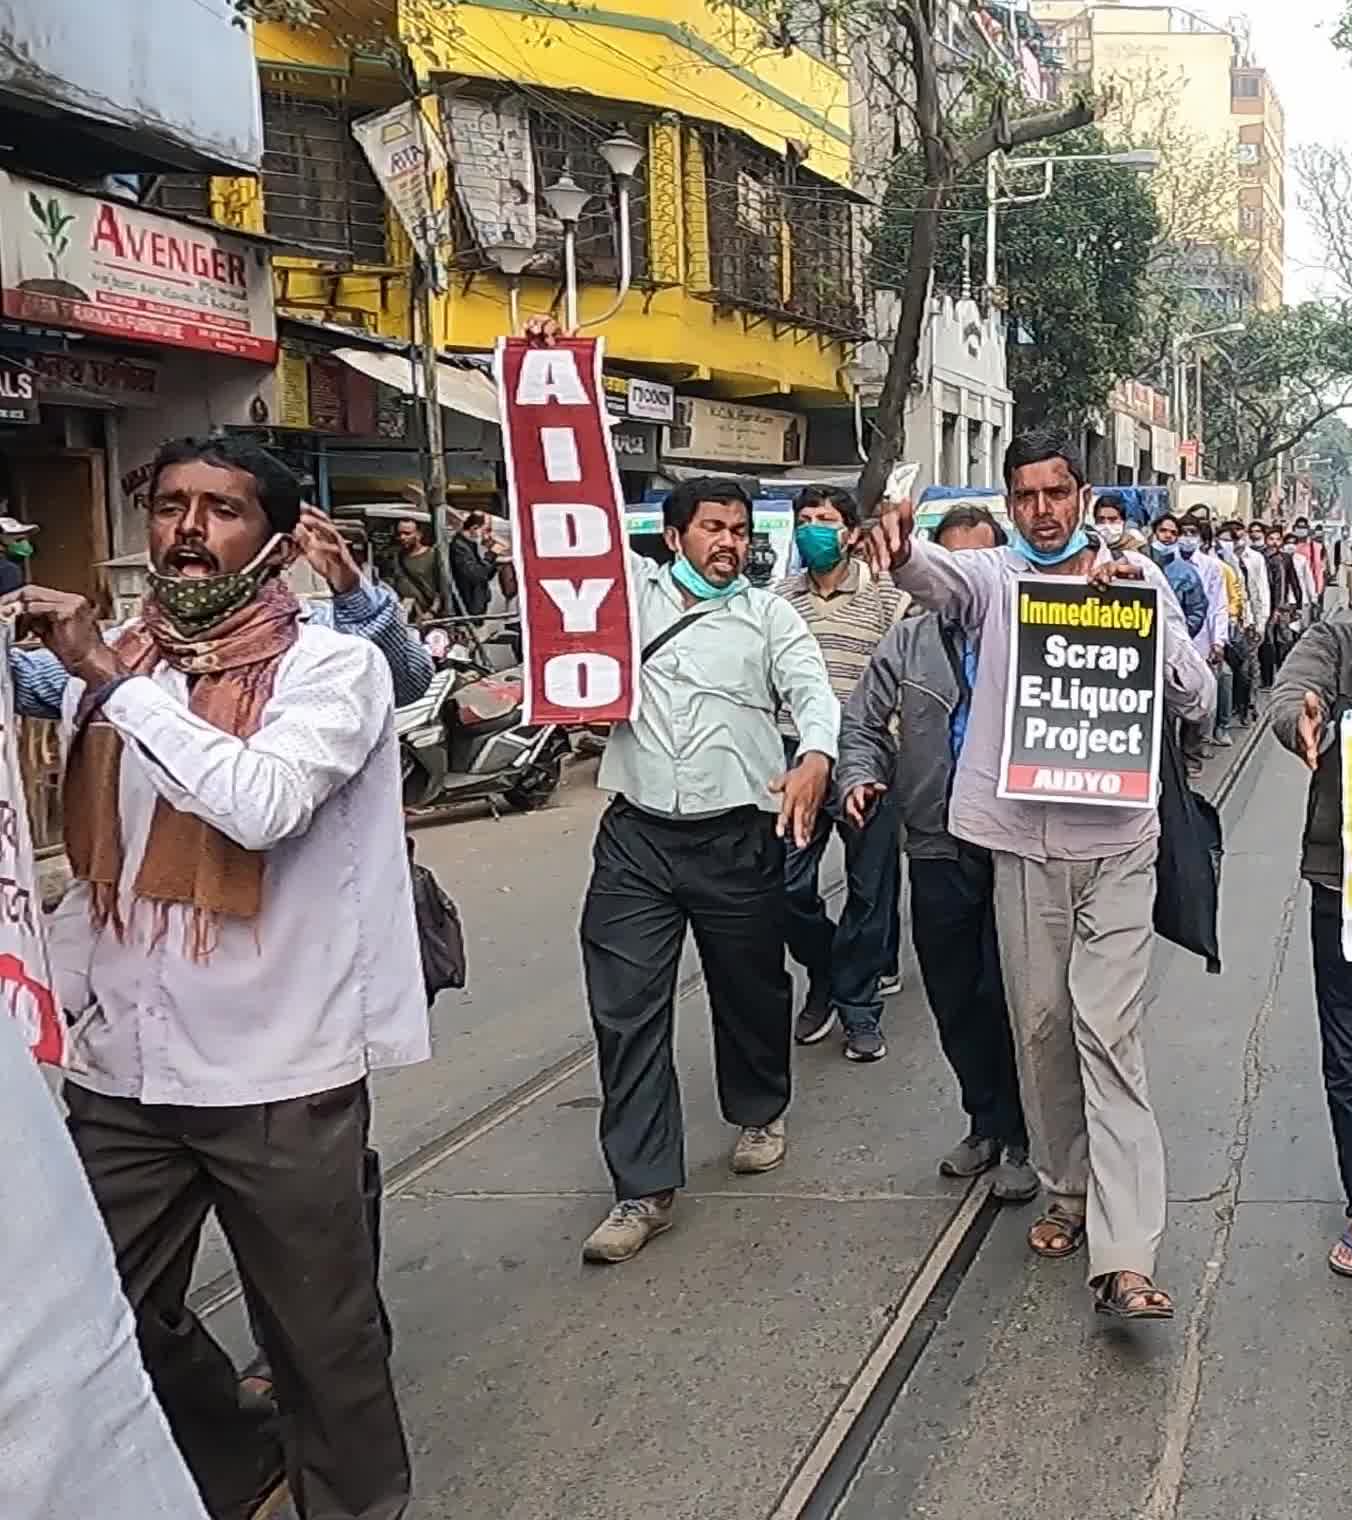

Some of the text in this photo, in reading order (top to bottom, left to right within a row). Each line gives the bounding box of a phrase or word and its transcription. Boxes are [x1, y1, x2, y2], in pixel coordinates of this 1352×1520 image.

[92, 202, 247, 288] AVENGER
[514, 349, 622, 708] AIDYO
[1020, 593, 1153, 638] Immediately
[1044, 634, 1140, 679] Scrap
[1020, 675, 1153, 718] E-Liquor
[1024, 717, 1142, 760] Project
[1032, 768, 1121, 794] AIDYO
